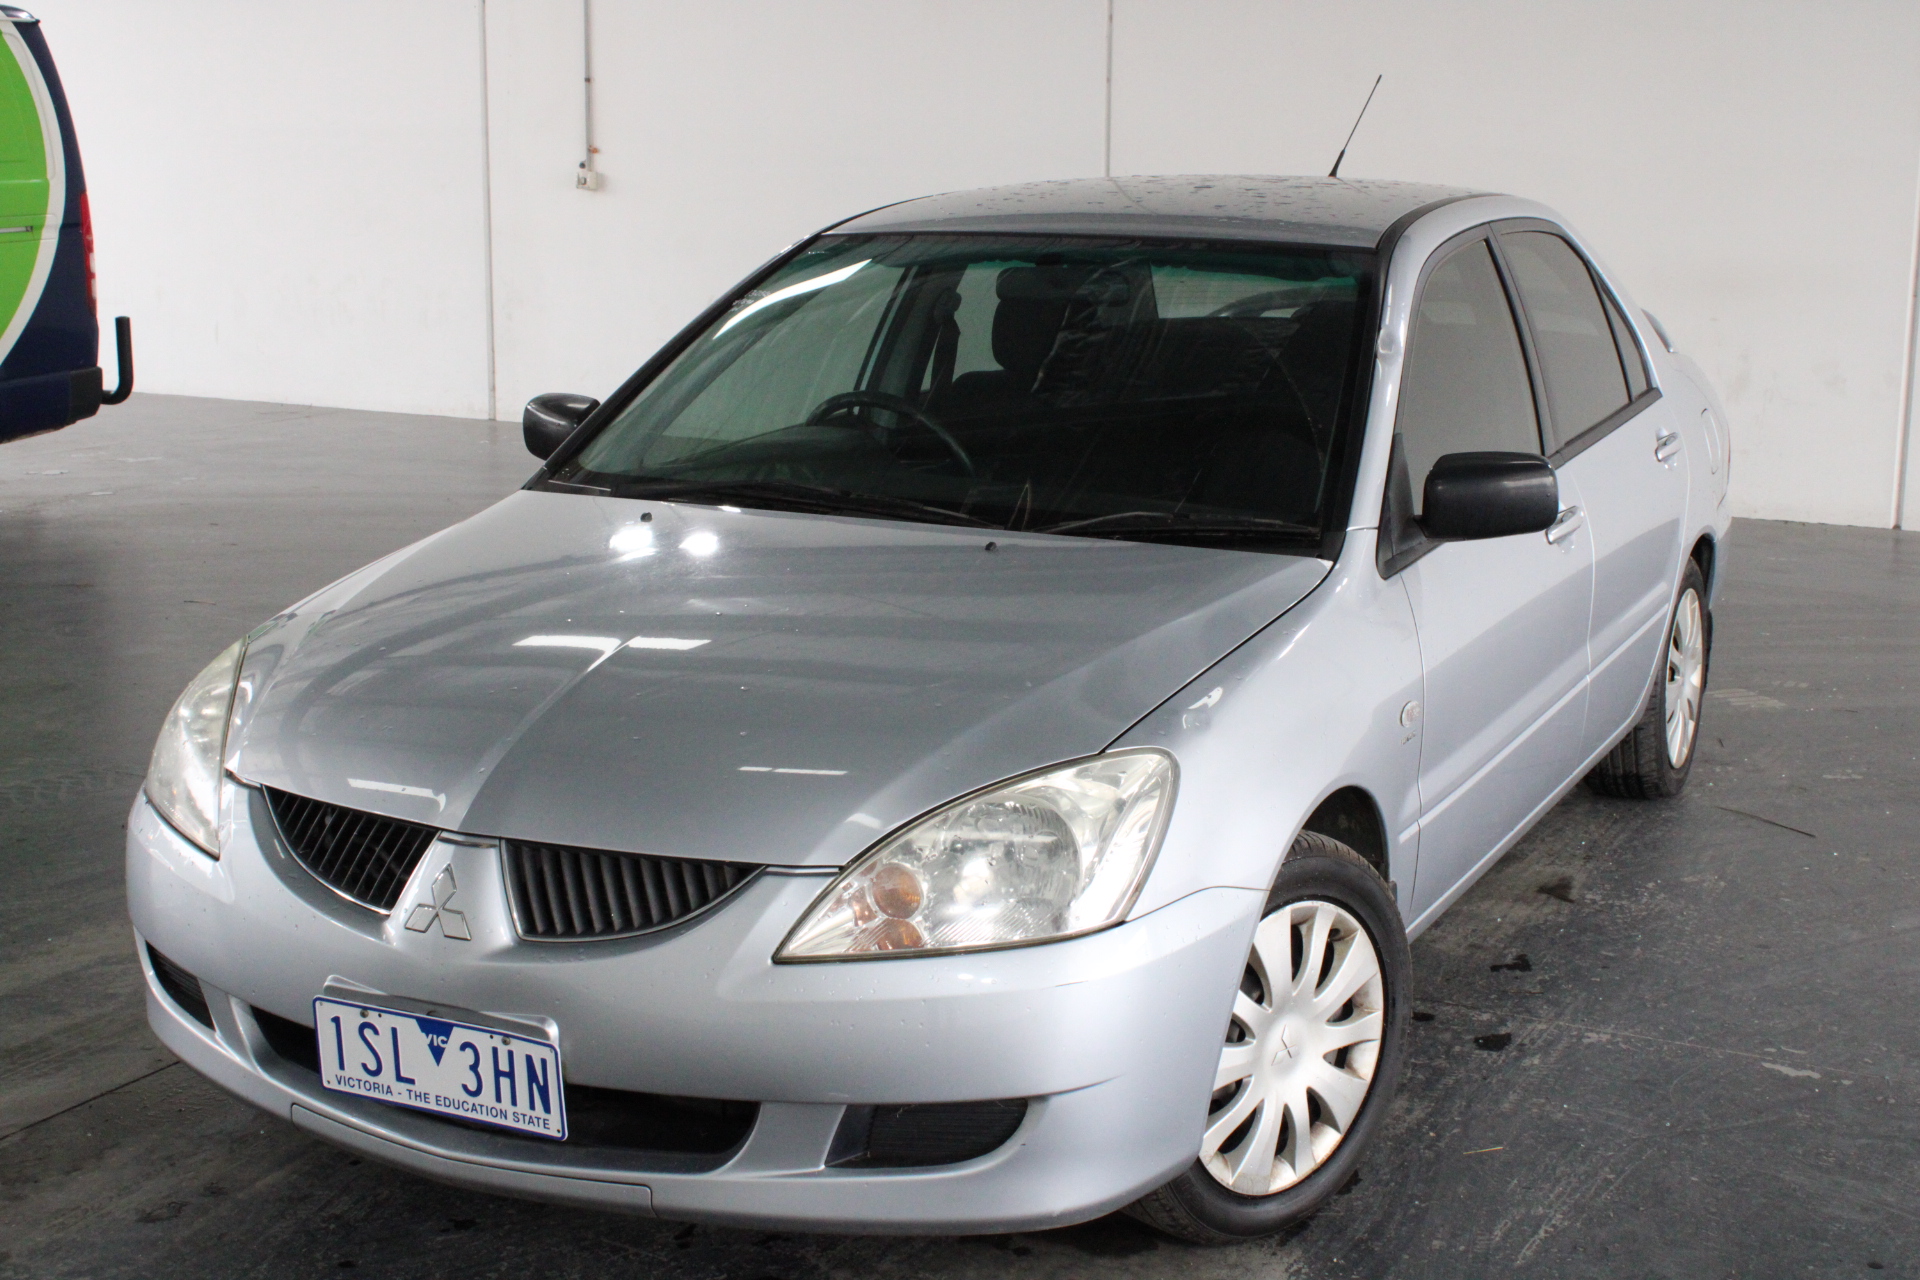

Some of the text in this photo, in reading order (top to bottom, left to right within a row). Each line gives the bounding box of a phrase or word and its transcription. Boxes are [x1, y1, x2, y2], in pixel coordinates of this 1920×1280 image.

[331, 1015, 552, 1114] 1SL 3HN
[422, 1032, 448, 1048] VIC
[335, 1074, 393, 1097] VICTORIA
[406, 1089, 431, 1104] THE
[435, 1095, 508, 1120] EDUCATION
[512, 1111, 551, 1130] STATE
